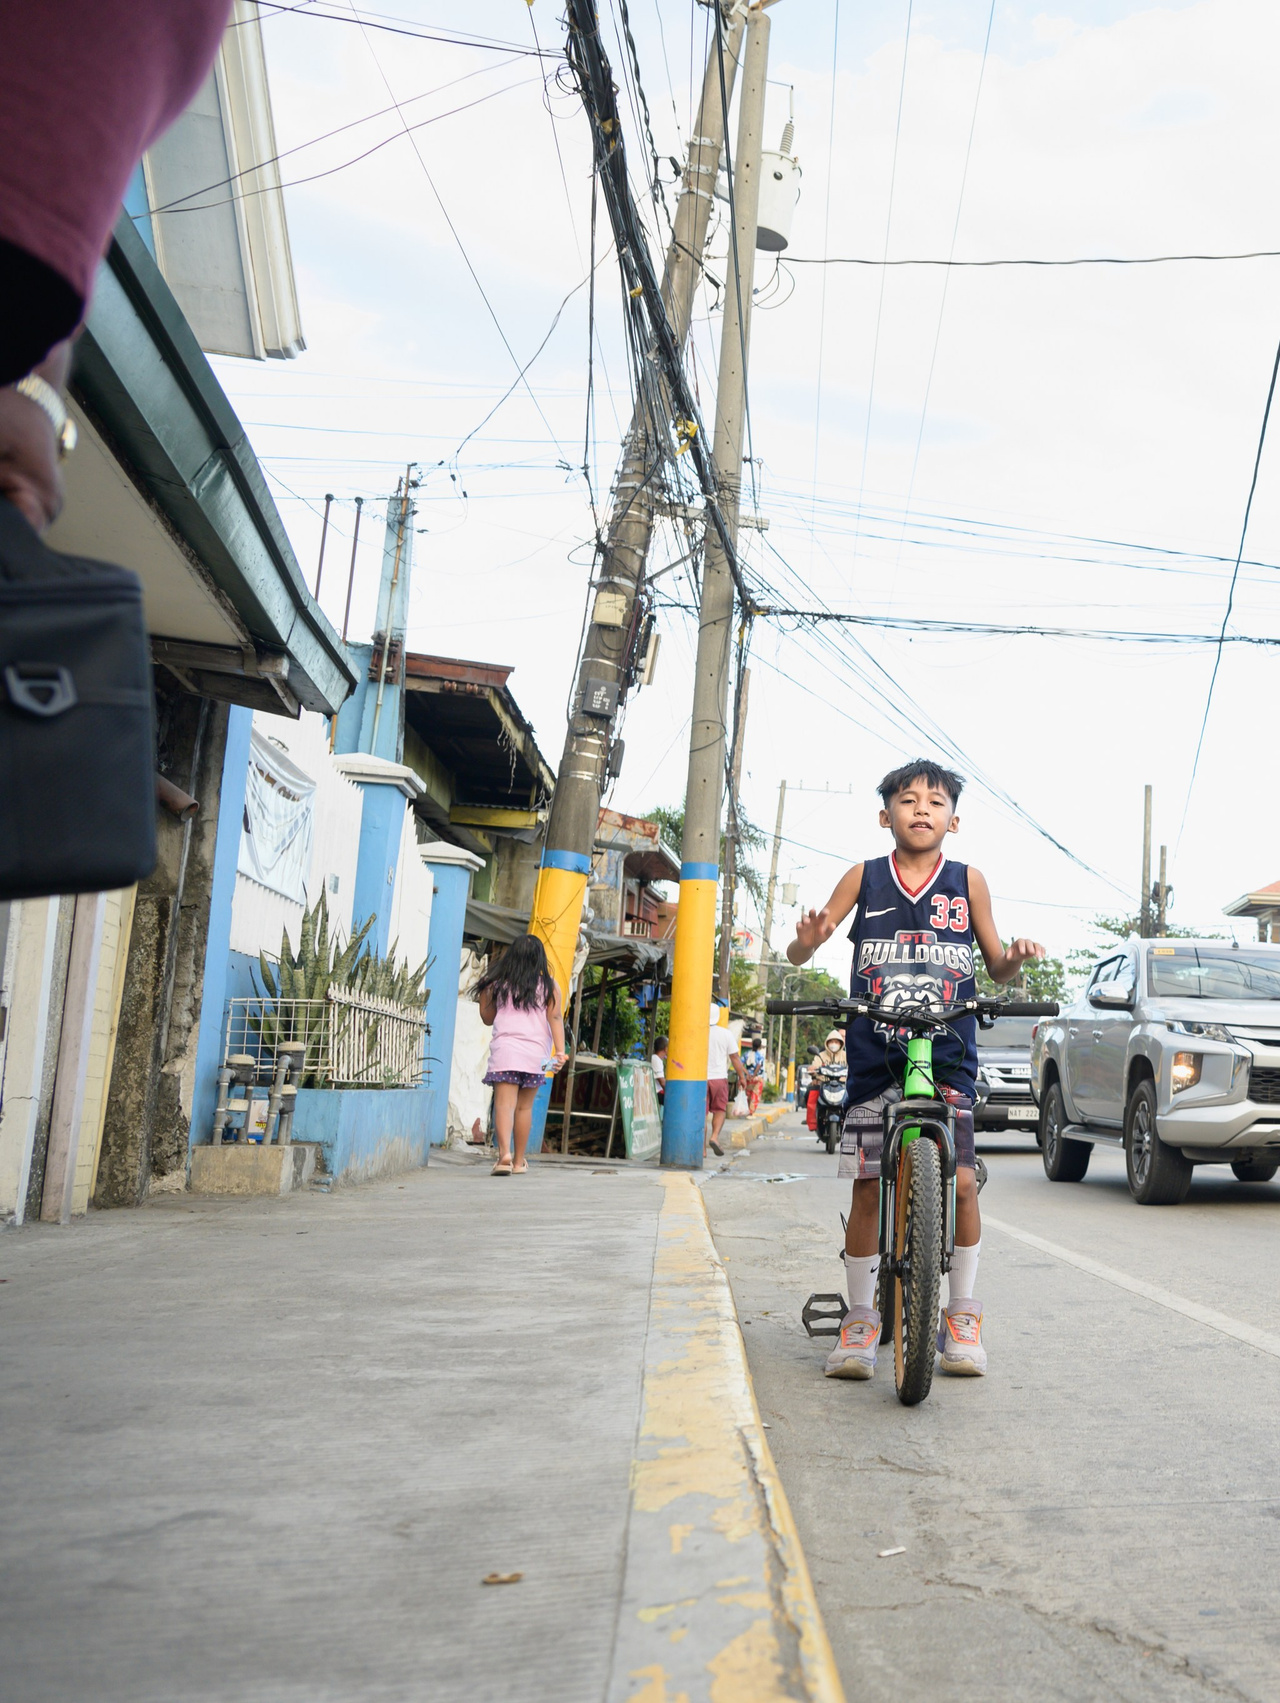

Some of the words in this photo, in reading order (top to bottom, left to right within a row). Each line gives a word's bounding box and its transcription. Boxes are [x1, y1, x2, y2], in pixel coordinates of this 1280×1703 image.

[930, 893, 969, 933] 33
[899, 933, 933, 945] PTC
[858, 942, 973, 976] BULLDOGS
[1025, 1109, 1039, 1117] 222
